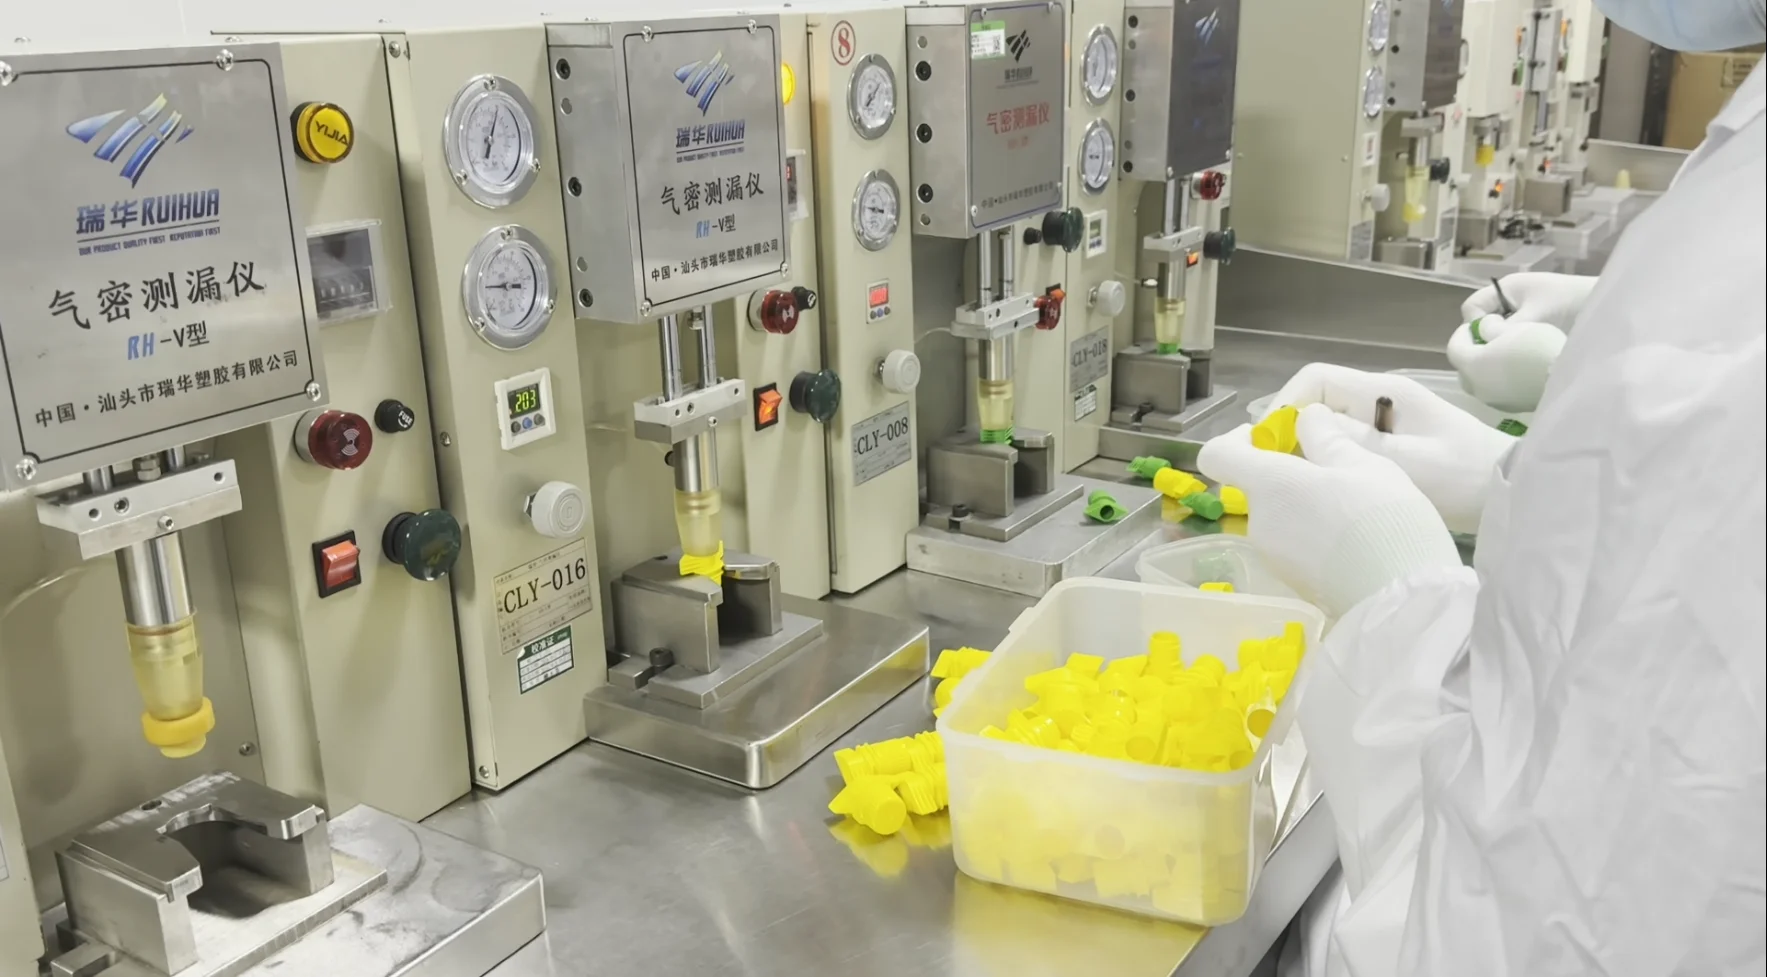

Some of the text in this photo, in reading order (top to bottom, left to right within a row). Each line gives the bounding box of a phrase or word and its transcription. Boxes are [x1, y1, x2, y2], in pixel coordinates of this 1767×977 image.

[838, 27, 851, 58] 8
[706, 119, 745, 144] RUIHUA
[660, 172, 764, 215] 气密测漏仪
[76, 188, 220, 235] 瑞华 RUIHUA
[93, 242, 121, 253] PRODUCT
[123, 238, 148, 249] QUALITY
[149, 235, 166, 245] FIRST
[205, 226, 221, 236] FIRST
[48, 261, 265, 330] 气密测漏仪
[399, 410, 413, 426] FUSE
[515, 389, 536, 412] 203
[857, 416, 908, 455] CLY-008
[503, 557, 586, 614] CLY-016
